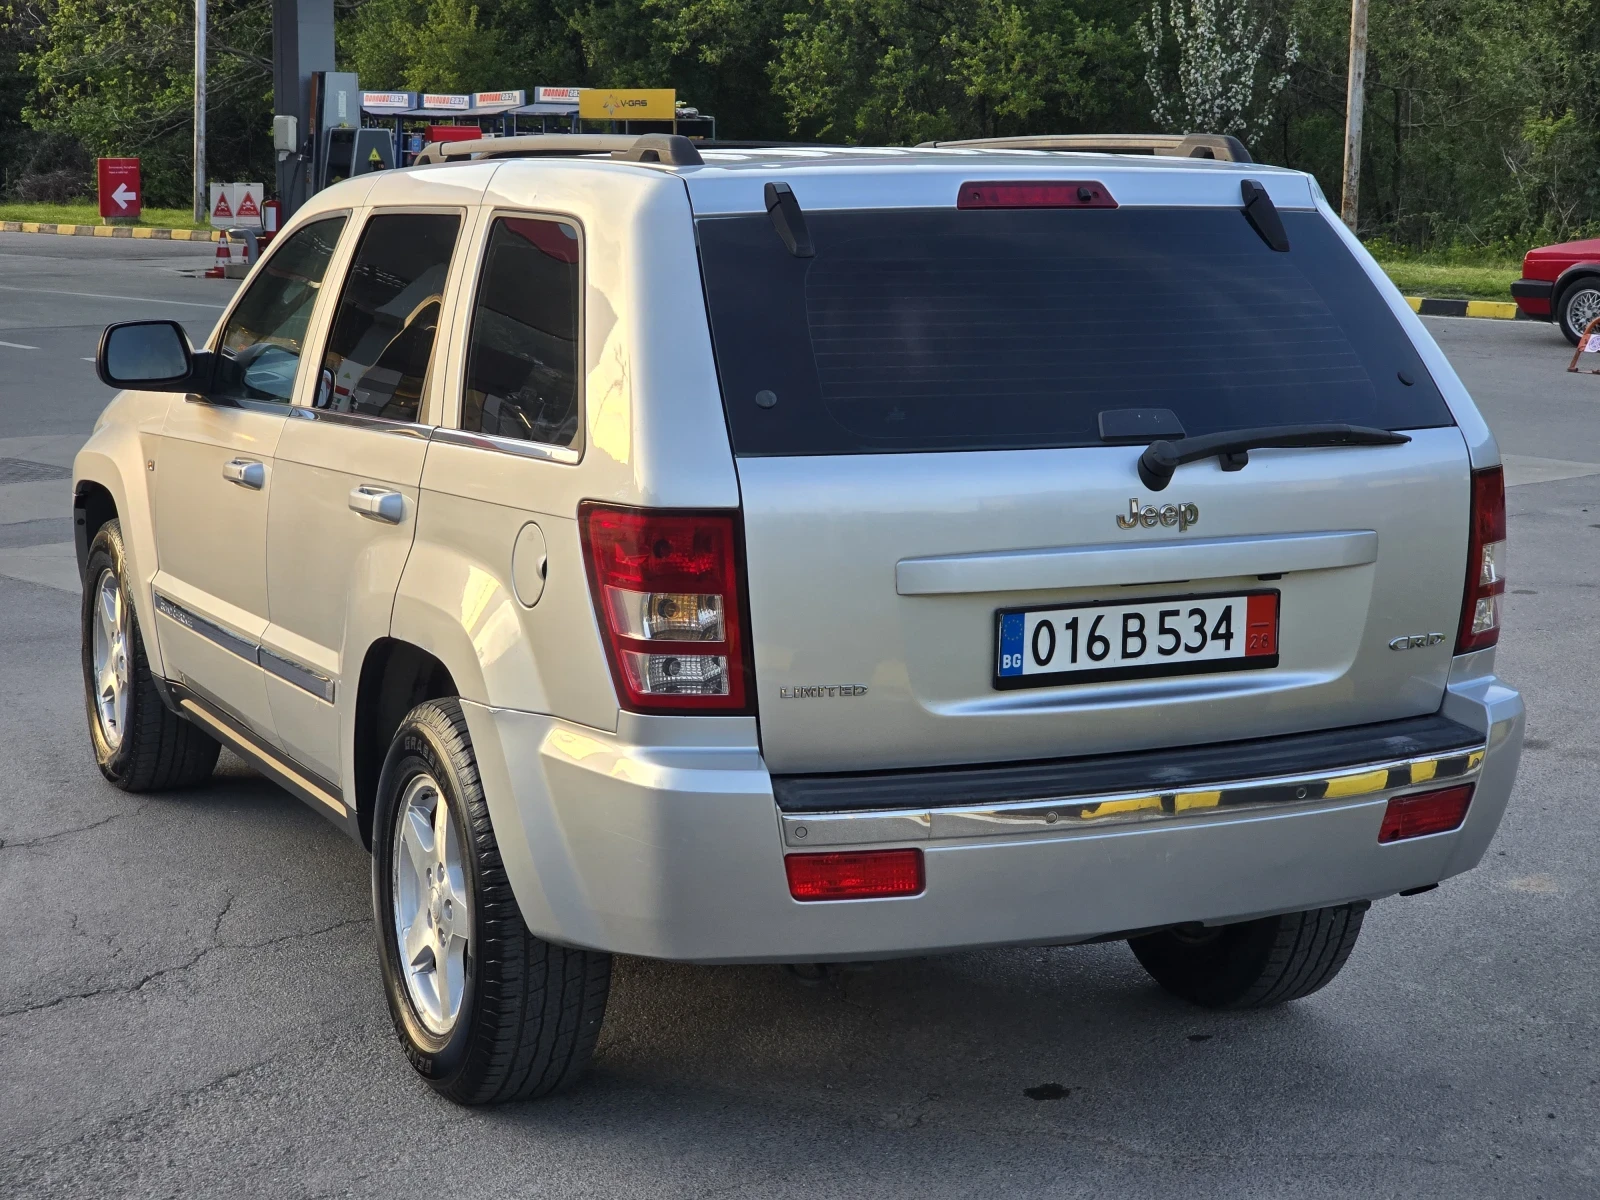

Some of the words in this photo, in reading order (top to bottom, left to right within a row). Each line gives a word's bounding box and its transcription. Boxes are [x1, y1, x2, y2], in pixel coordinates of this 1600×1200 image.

[620, 99, 648, 107] V-GAS
[1116, 497, 1199, 533] Jeep
[1249, 632, 1270, 650] 28
[1388, 632, 1446, 651] CRD
[1002, 653, 1022, 669] BG
[779, 683, 869, 699] LIMITED
